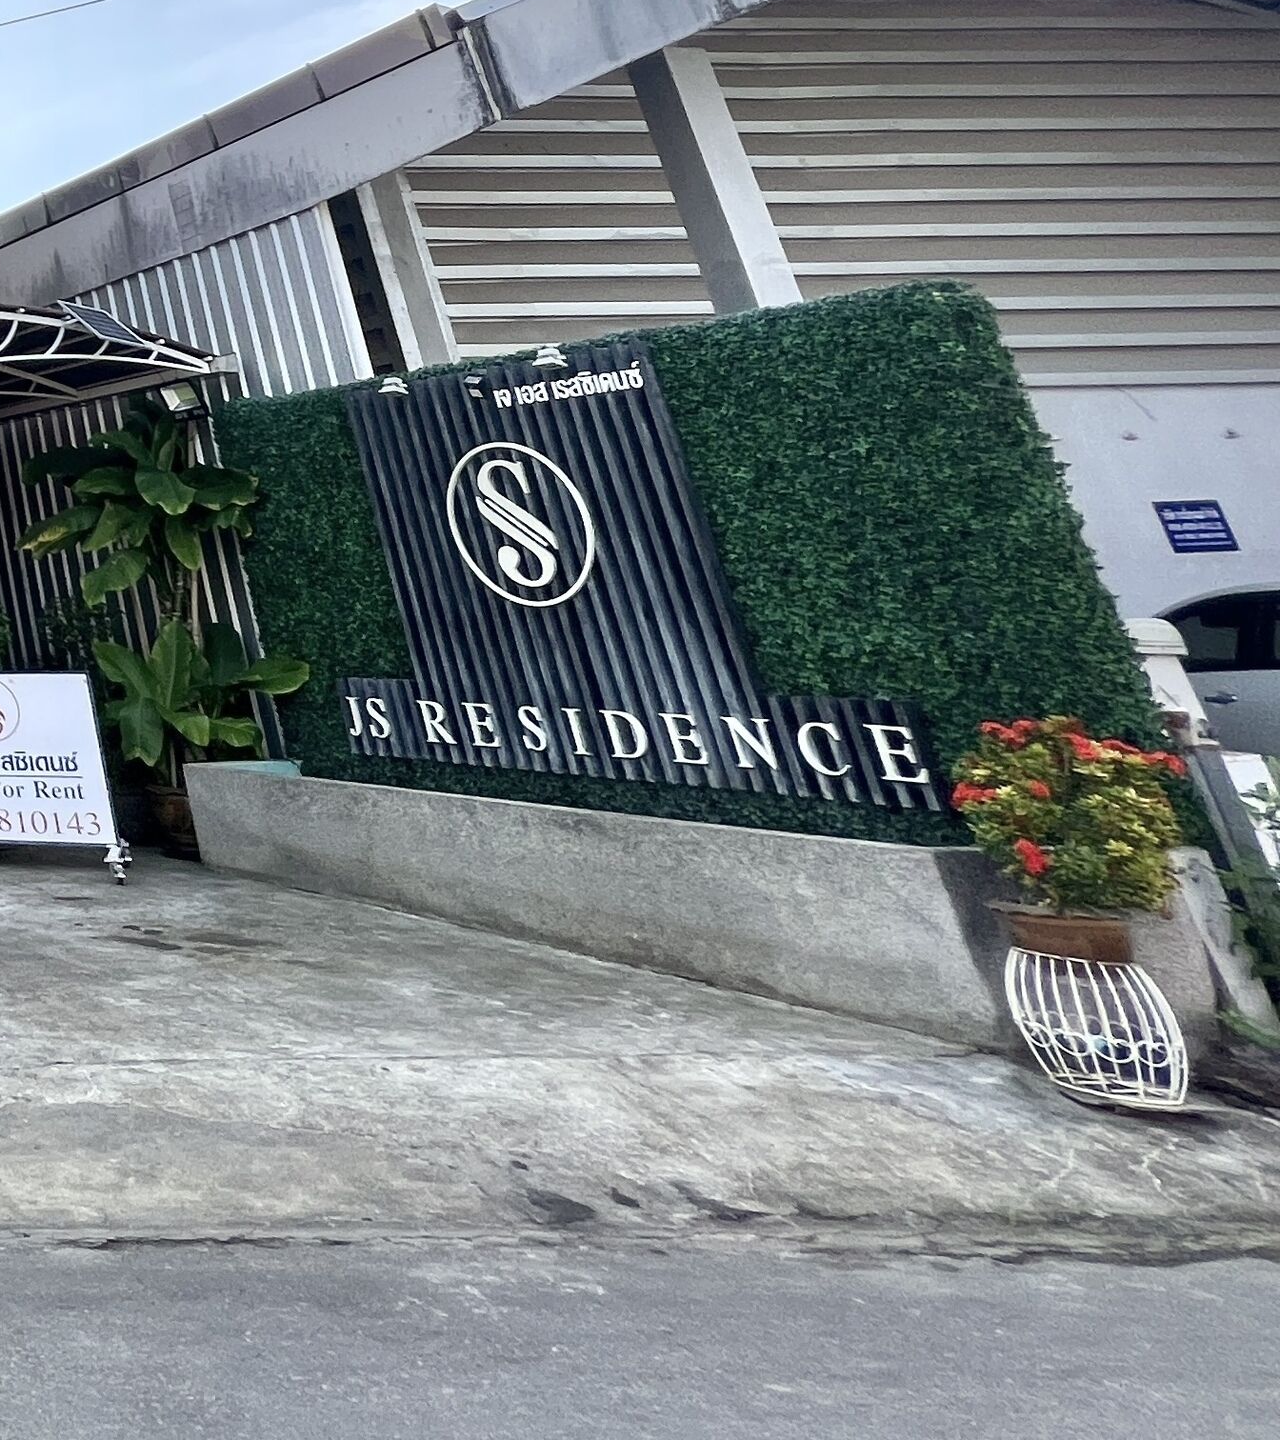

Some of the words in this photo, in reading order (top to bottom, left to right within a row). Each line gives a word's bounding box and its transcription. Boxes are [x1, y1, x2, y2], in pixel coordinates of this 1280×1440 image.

[345, 696, 391, 739] JS
[416, 698, 930, 784] RESIDENCE
[33, 780, 85, 800] Rent
